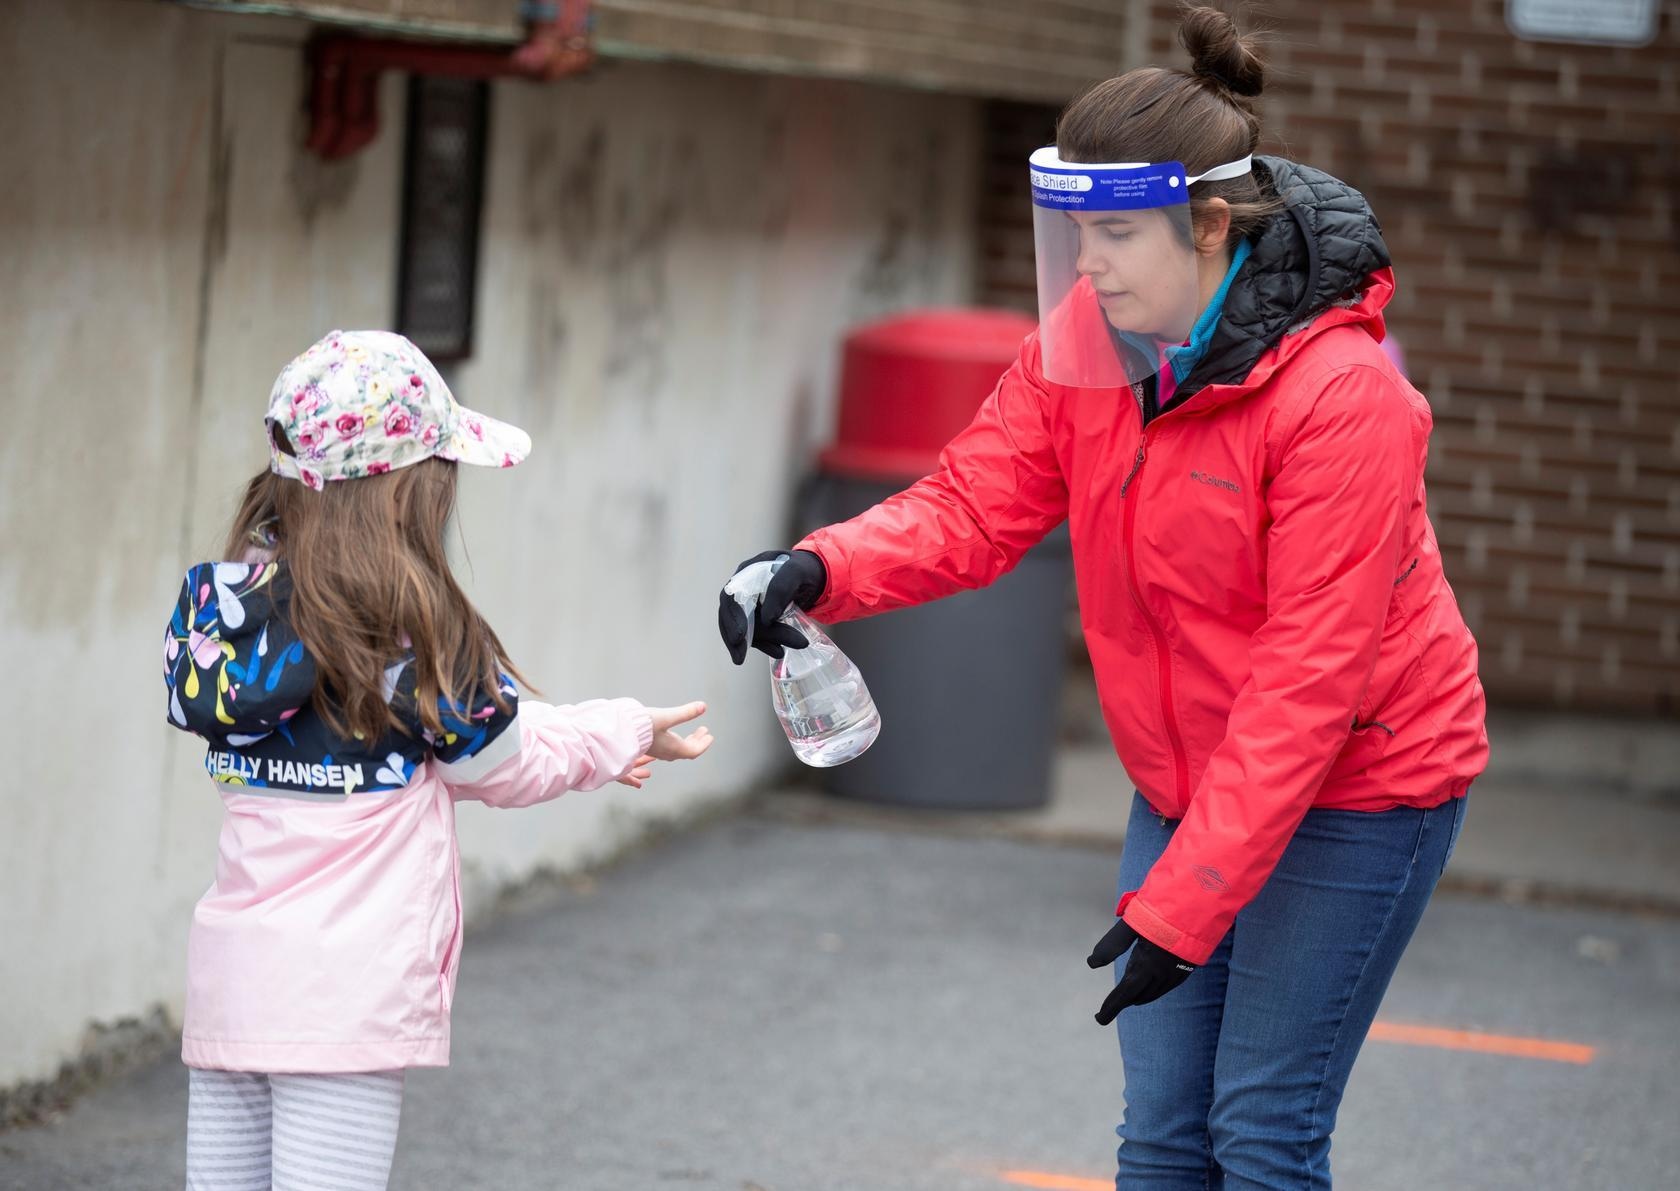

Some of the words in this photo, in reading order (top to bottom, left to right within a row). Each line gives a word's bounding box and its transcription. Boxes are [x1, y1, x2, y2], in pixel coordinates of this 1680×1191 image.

[1042, 174, 1078, 190] Shield
[207, 751, 261, 779] HELLY
[268, 760, 364, 787] HANSEN
